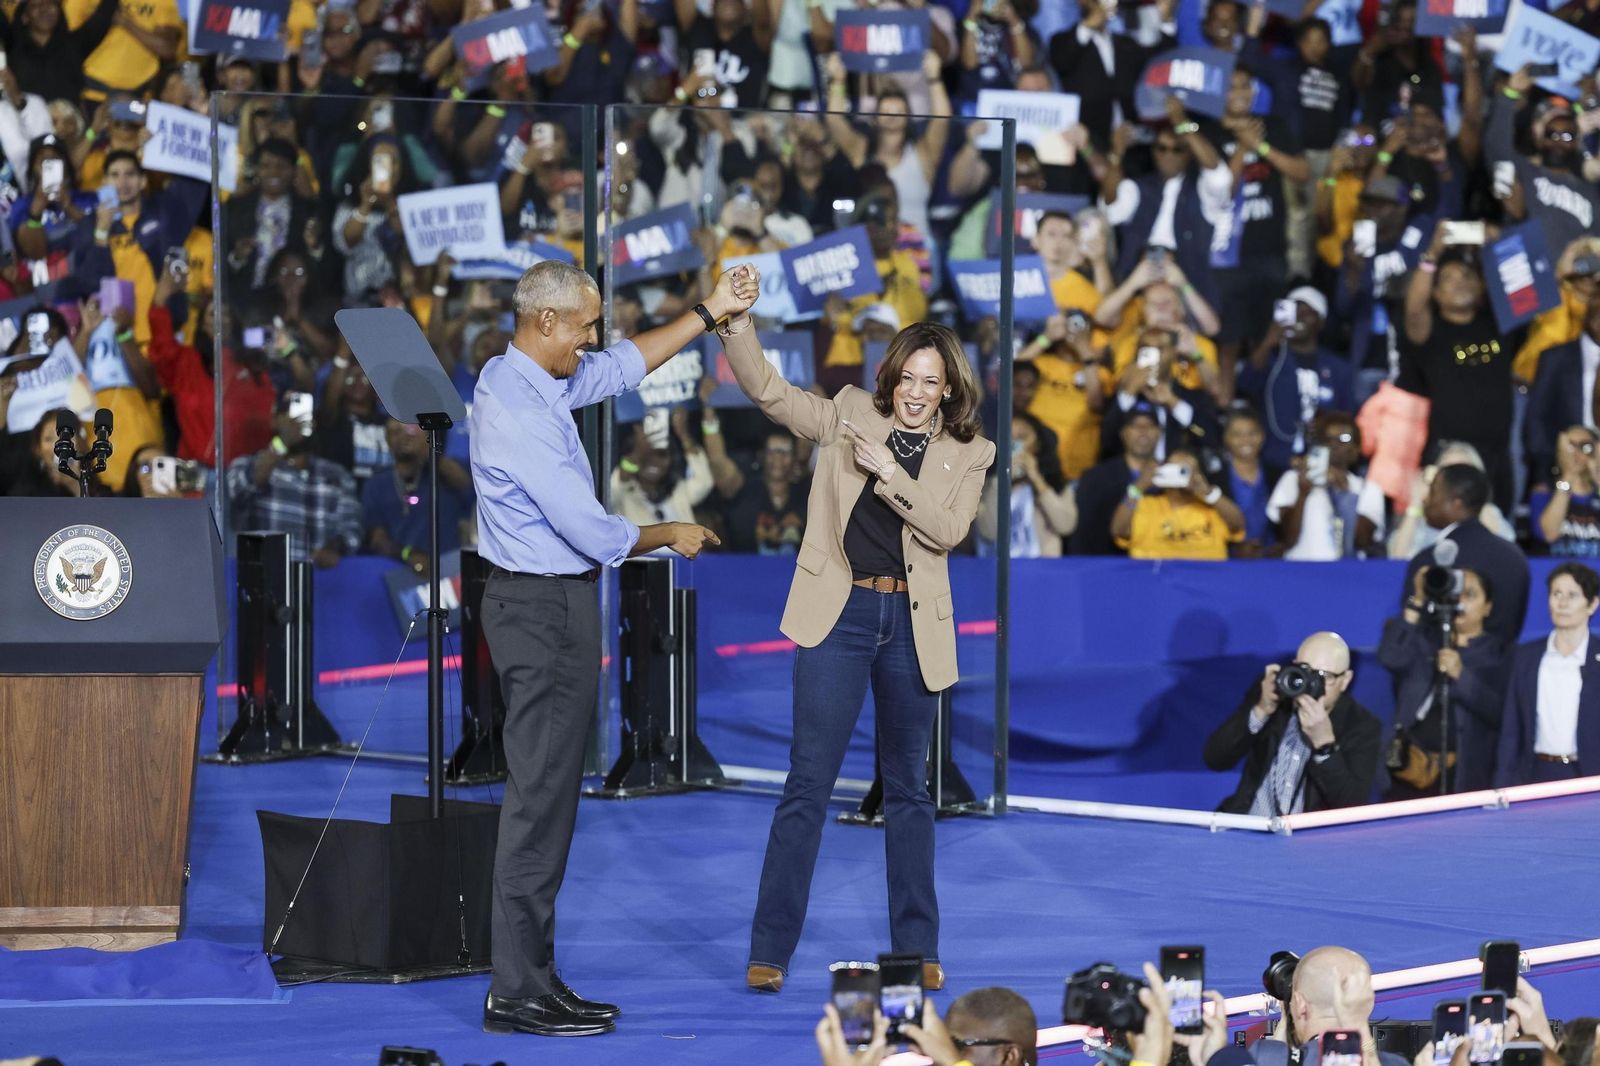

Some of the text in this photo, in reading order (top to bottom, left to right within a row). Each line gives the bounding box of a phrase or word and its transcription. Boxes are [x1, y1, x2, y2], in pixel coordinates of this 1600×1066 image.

[36, 528, 130, 614] VICE PRESIDENT OF THE UNITED STATES
